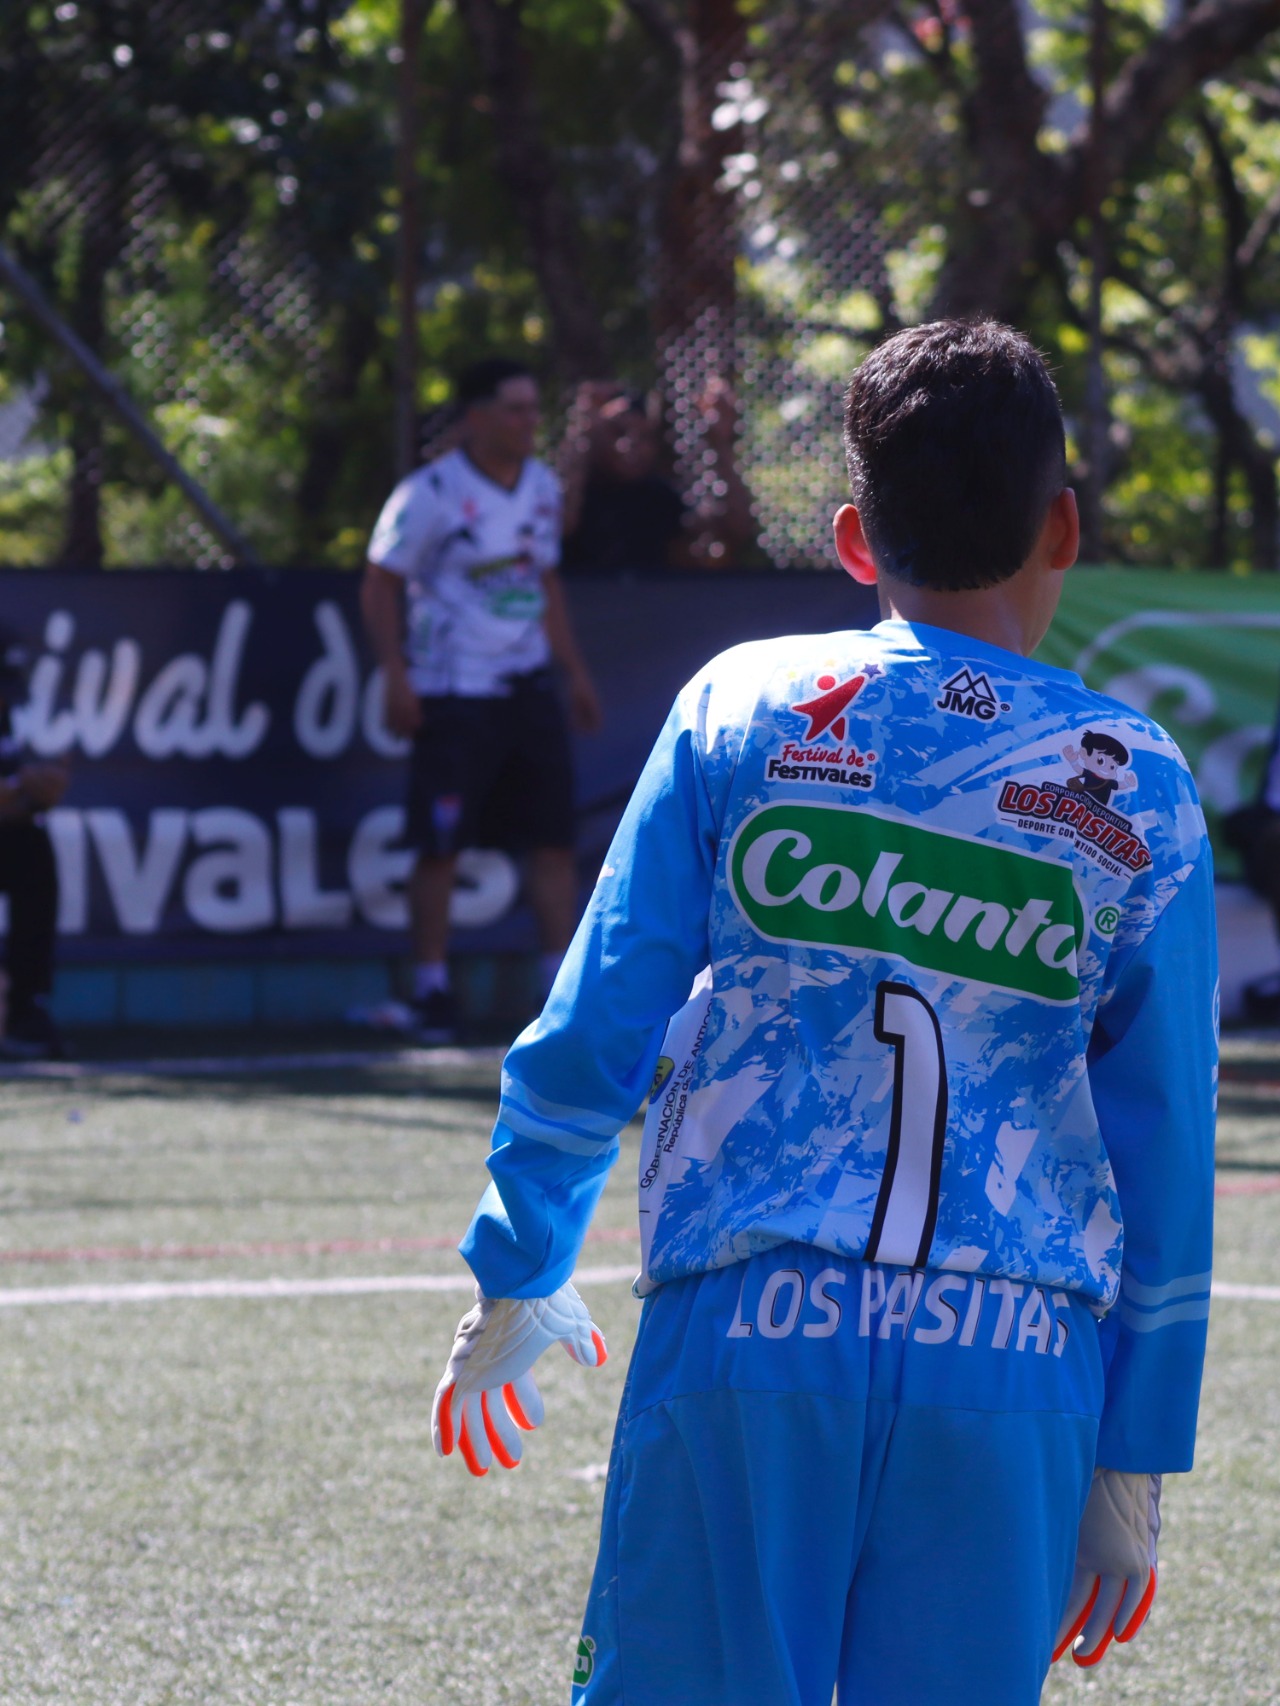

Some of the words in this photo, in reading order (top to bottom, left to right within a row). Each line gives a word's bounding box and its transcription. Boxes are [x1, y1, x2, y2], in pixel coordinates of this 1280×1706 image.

[10, 599, 269, 758] ival
[937, 691, 997, 720] JMG
[782, 743, 844, 764] Festival
[846, 748, 865, 768] de
[1000, 785, 1057, 816] LOS
[1053, 796, 1152, 869] PAISITAS
[1018, 818, 1056, 835] DEPORTE
[1097, 853, 1122, 877] SOCIAL
[1092, 804, 1130, 832] DEPORTIVA
[678, 1060, 694, 1079] DE
[663, 1094, 687, 1153] República
[863, 980, 949, 1267] 1
[726, 1268, 846, 1339] LOS
